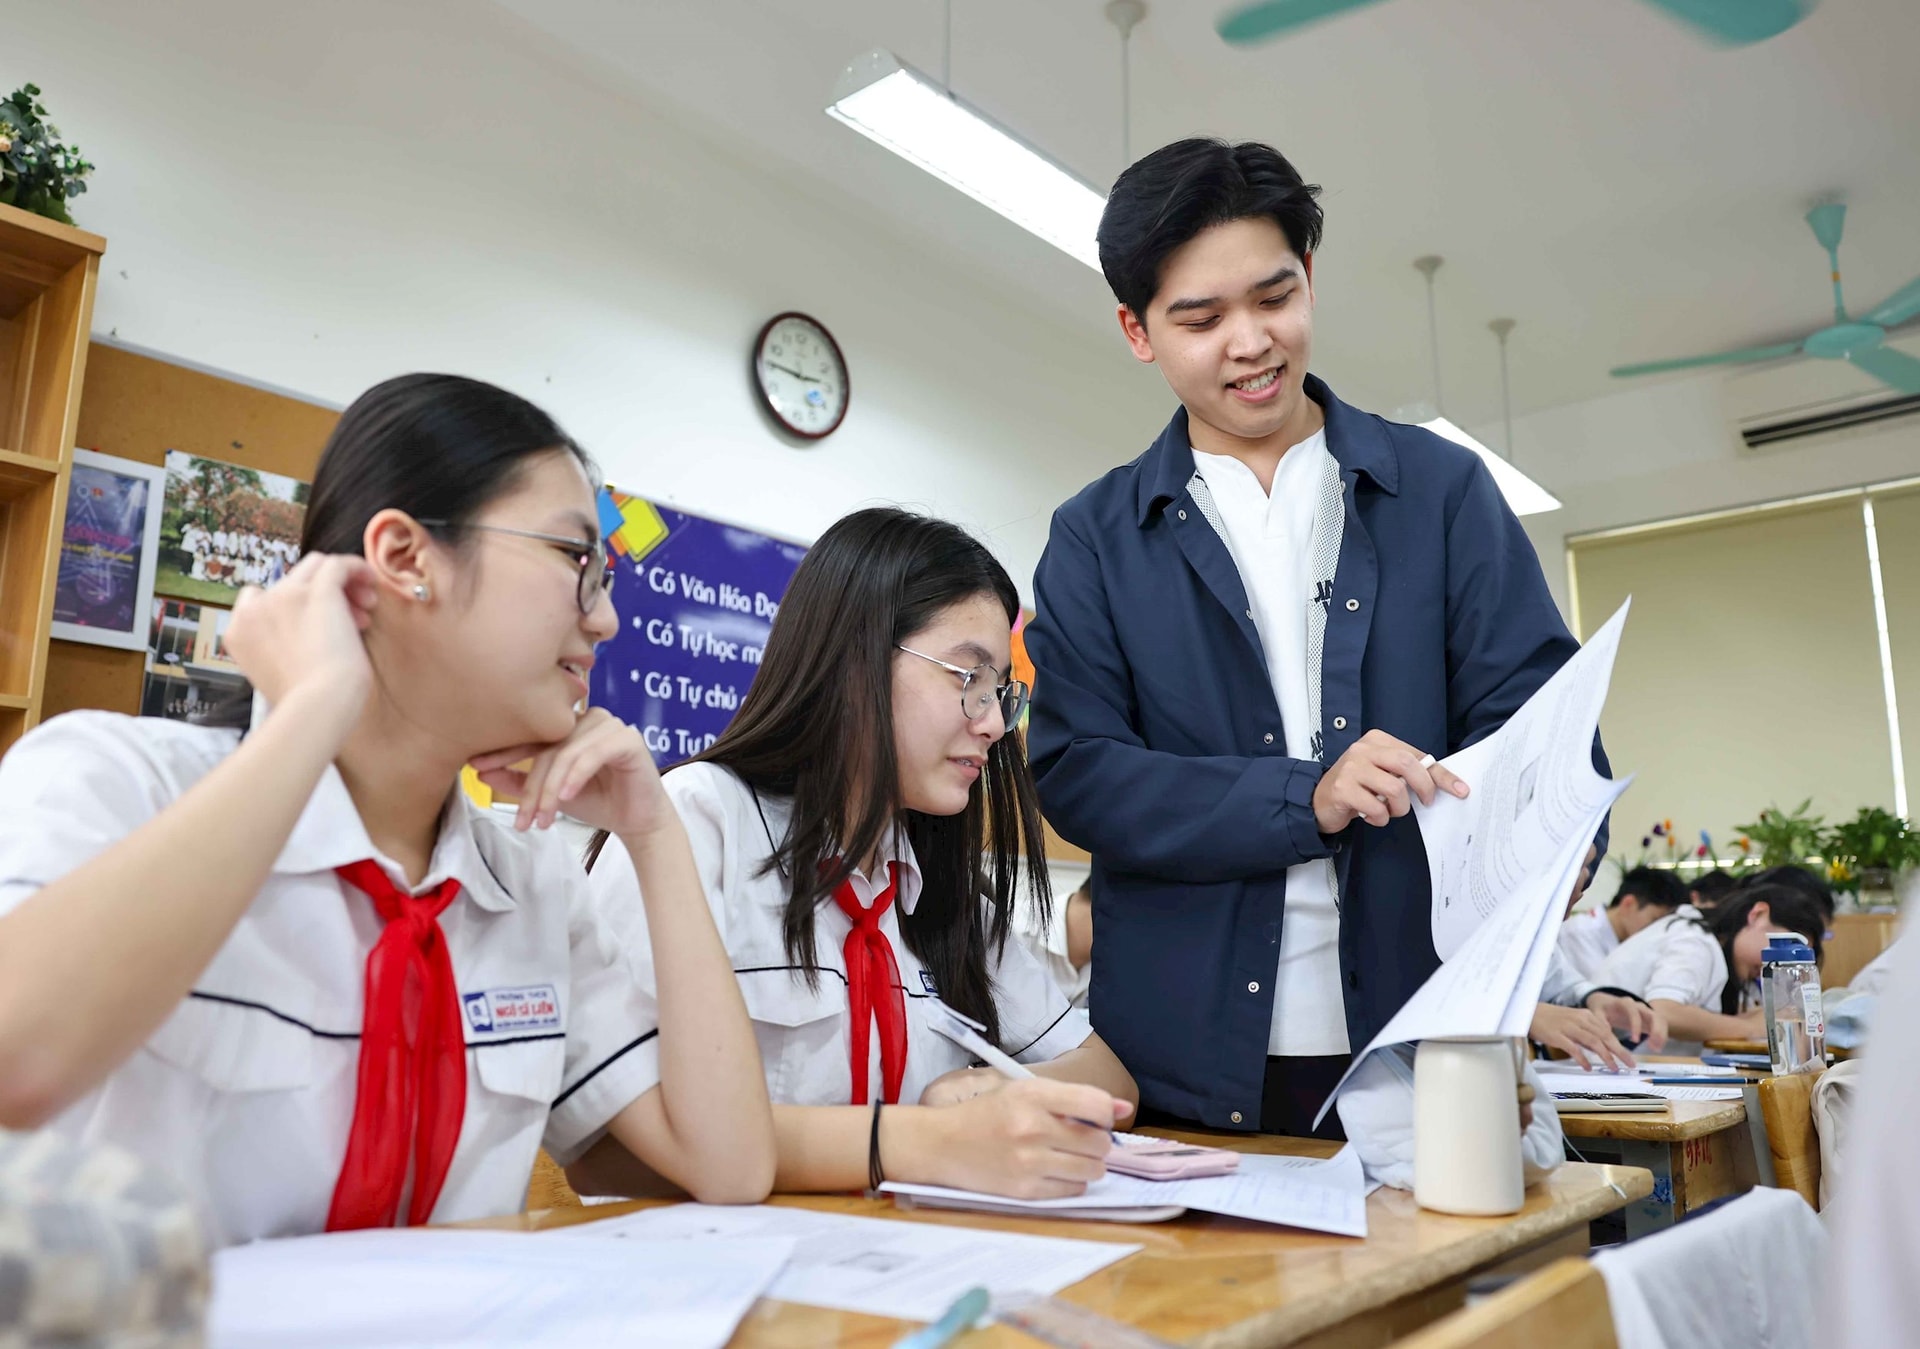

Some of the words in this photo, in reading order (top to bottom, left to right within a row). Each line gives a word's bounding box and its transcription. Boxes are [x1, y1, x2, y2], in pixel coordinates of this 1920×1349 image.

[648, 566, 676, 595] Có
[680, 572, 716, 606] Văn
[719, 582, 752, 614] Hóa
[646, 618, 674, 647] Có
[678, 623, 704, 659] Tự
[706, 629, 739, 664] học
[644, 671, 672, 699] Có
[676, 675, 703, 710] Tự
[704, 682, 738, 711] chủ
[642, 725, 671, 753] Có
